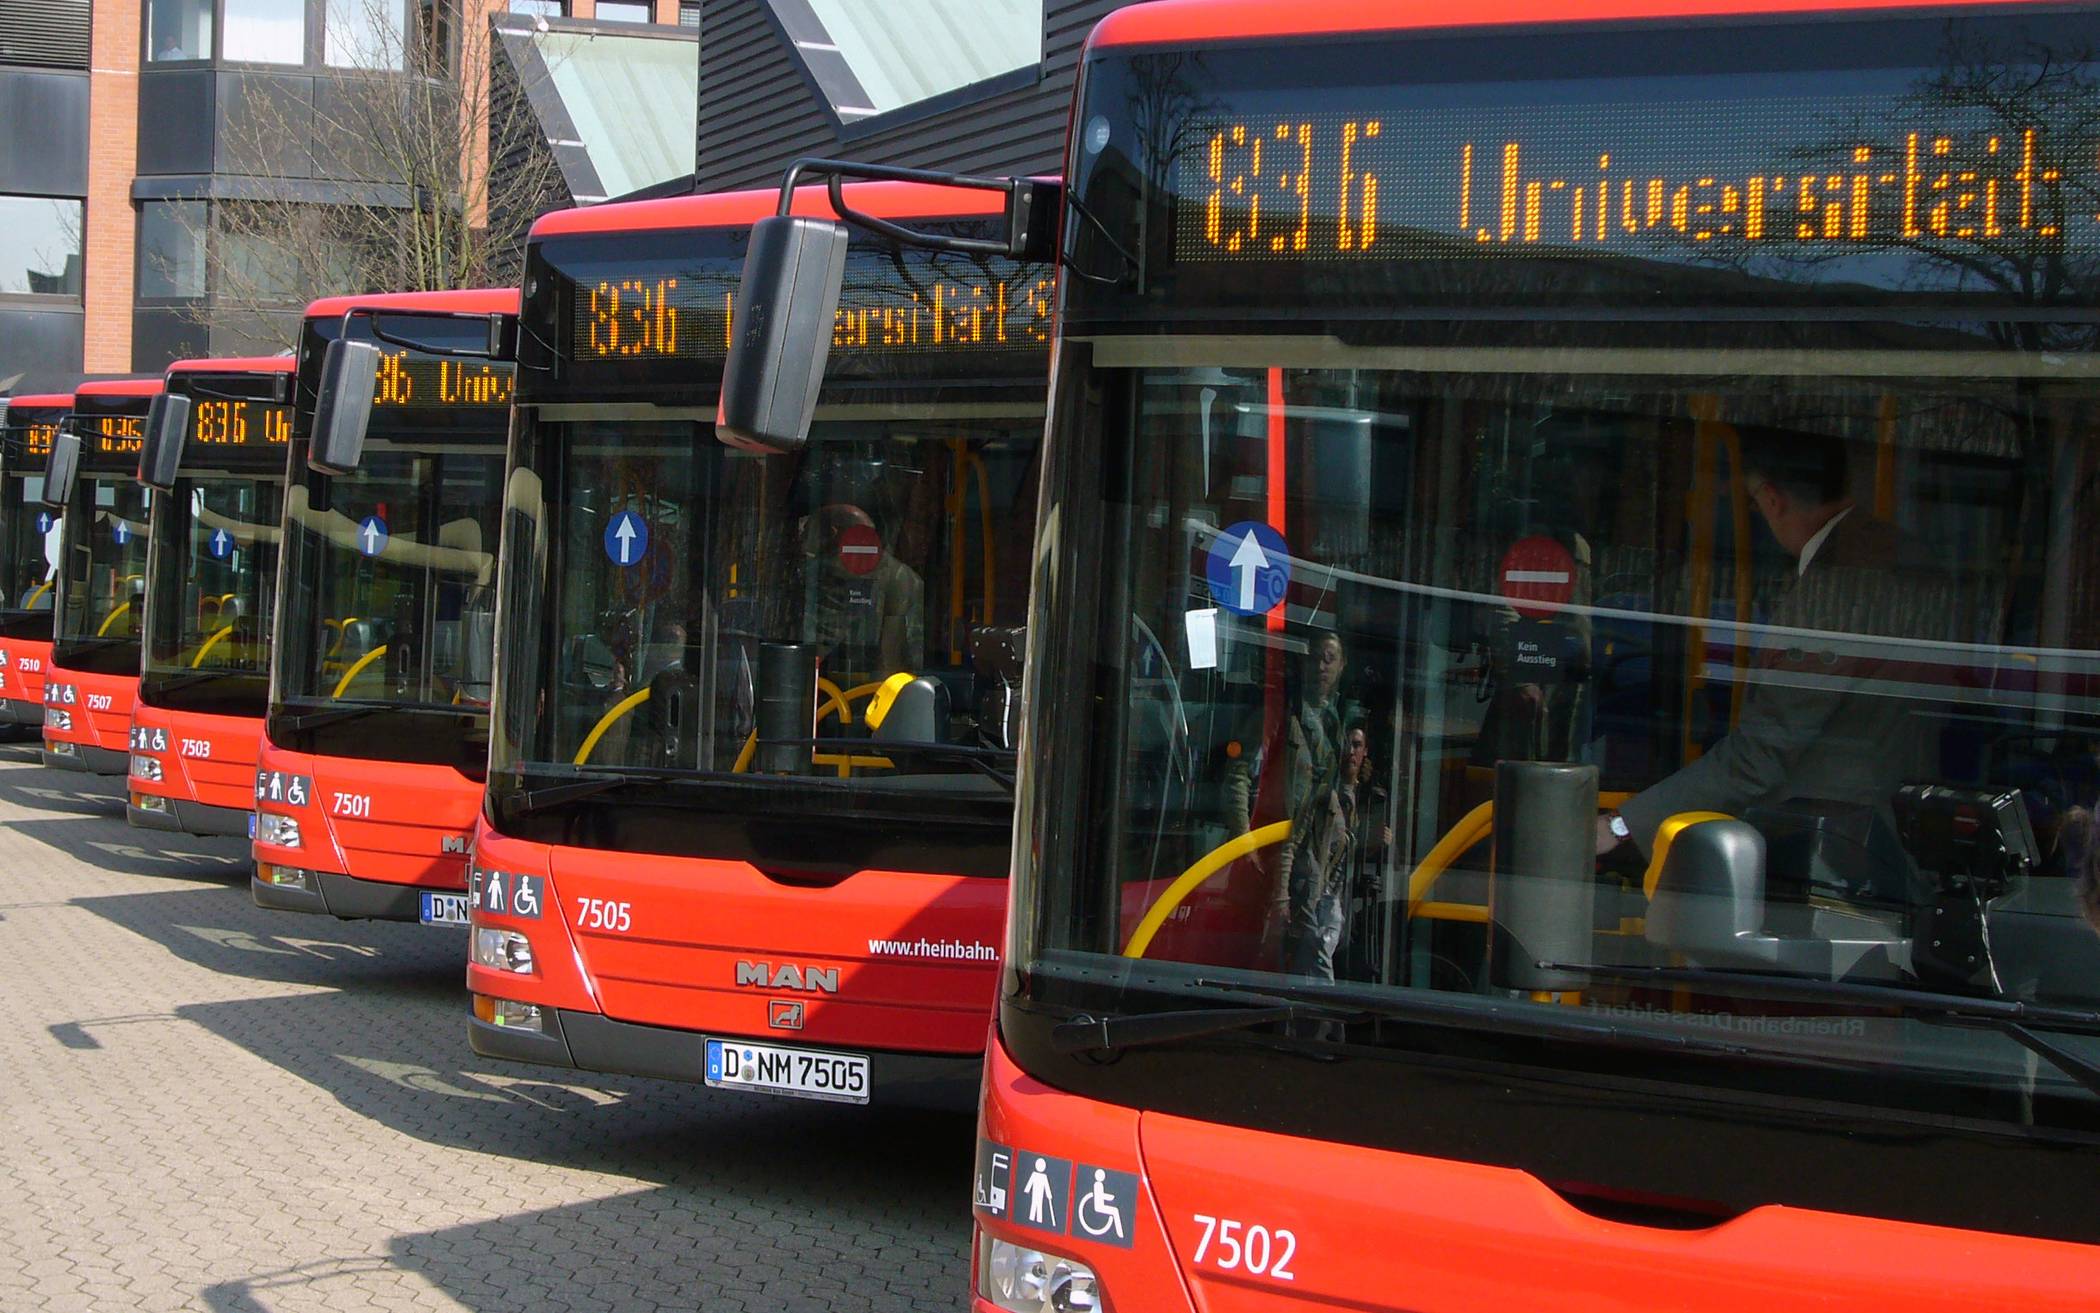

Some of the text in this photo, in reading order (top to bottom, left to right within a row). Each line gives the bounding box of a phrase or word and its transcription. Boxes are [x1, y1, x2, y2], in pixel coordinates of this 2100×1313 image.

[1205, 121, 1382, 252] 836
[1458, 127, 2062, 242] Universität
[591, 279, 678, 356] 836
[374, 351, 513, 404] 36 Univ
[197, 401, 248, 443] 836
[29, 423, 58, 454] 83
[1517, 653, 1557, 667] Ausstieg
[1518, 641, 1538, 652] Kein
[19, 658, 40, 672] 7510
[87, 694, 112, 710] 7507
[182, 738, 210, 758] 7503
[333, 792, 370, 817] 7501
[577, 897, 631, 932] 7505
[868, 938, 1000, 960] www.rheinbahn.
[736, 960, 839, 993] MAN
[724, 1049, 864, 1091] D NM 7505
[1193, 1214, 1297, 1280] 7502
